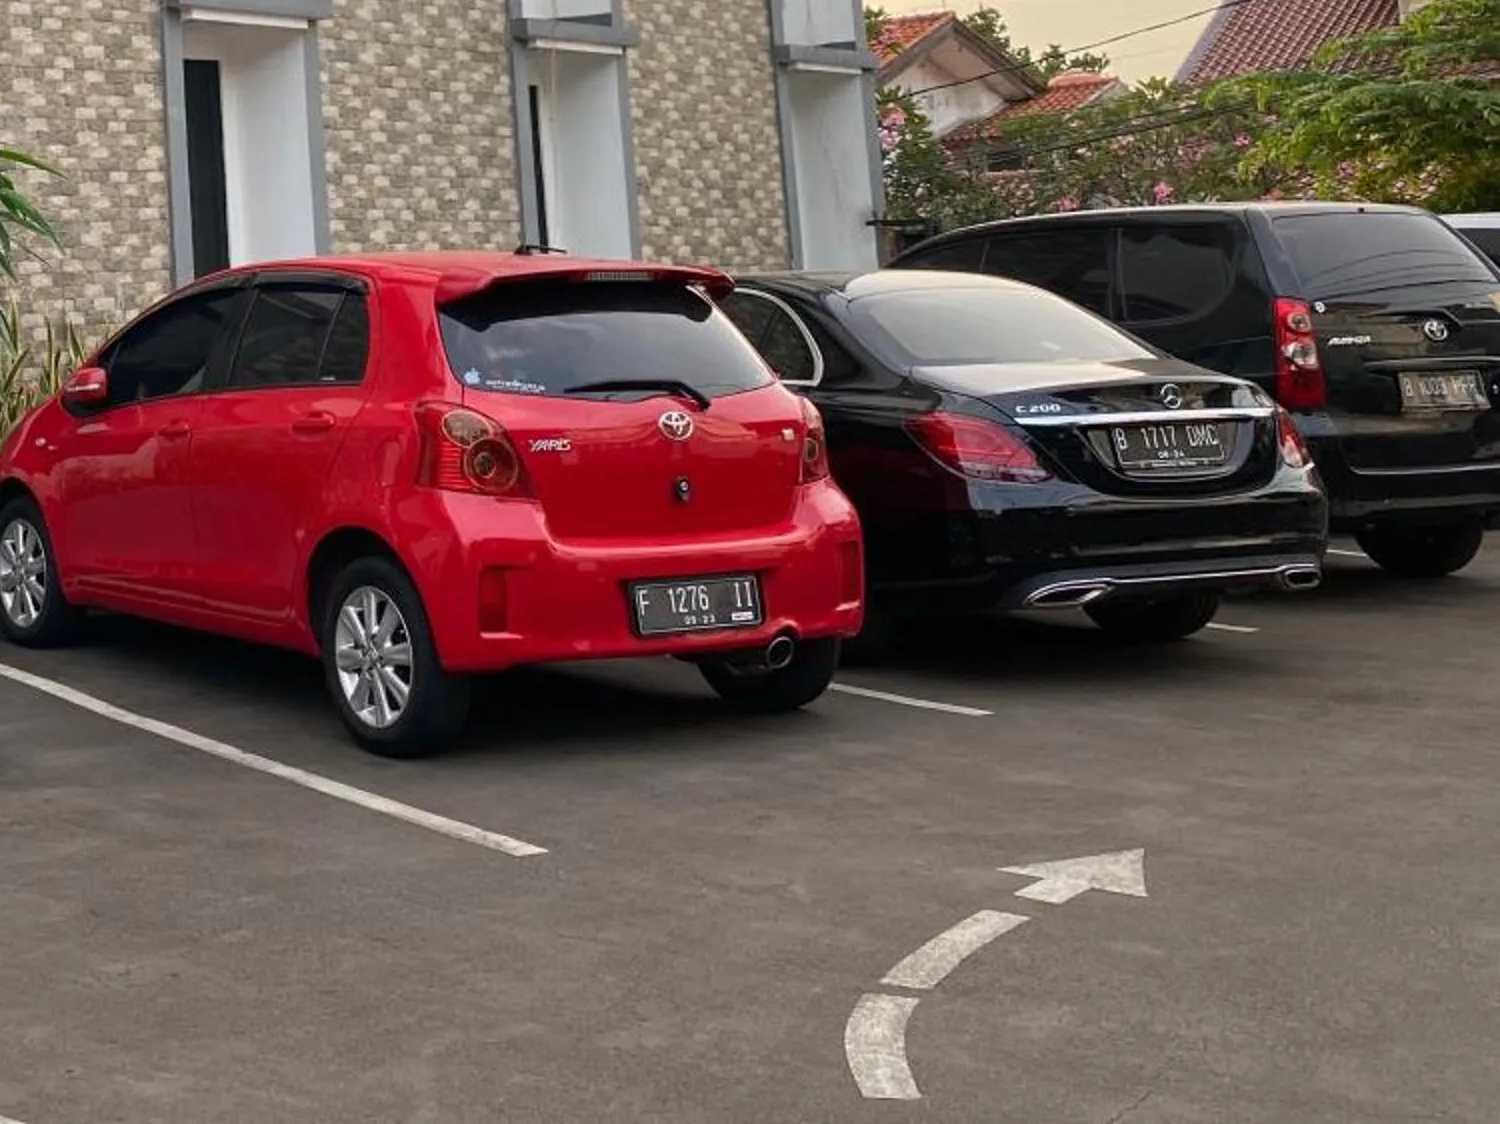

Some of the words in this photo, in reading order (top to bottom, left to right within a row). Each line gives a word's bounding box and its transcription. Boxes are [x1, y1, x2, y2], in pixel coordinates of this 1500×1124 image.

[1029, 403, 1061, 413] 200
[528, 438, 572, 453] YARIS
[1114, 427, 1129, 450] B
[1140, 424, 1177, 448] 1717
[1185, 423, 1220, 446] DMC
[639, 589, 650, 615] F
[667, 585, 709, 613] 1276
